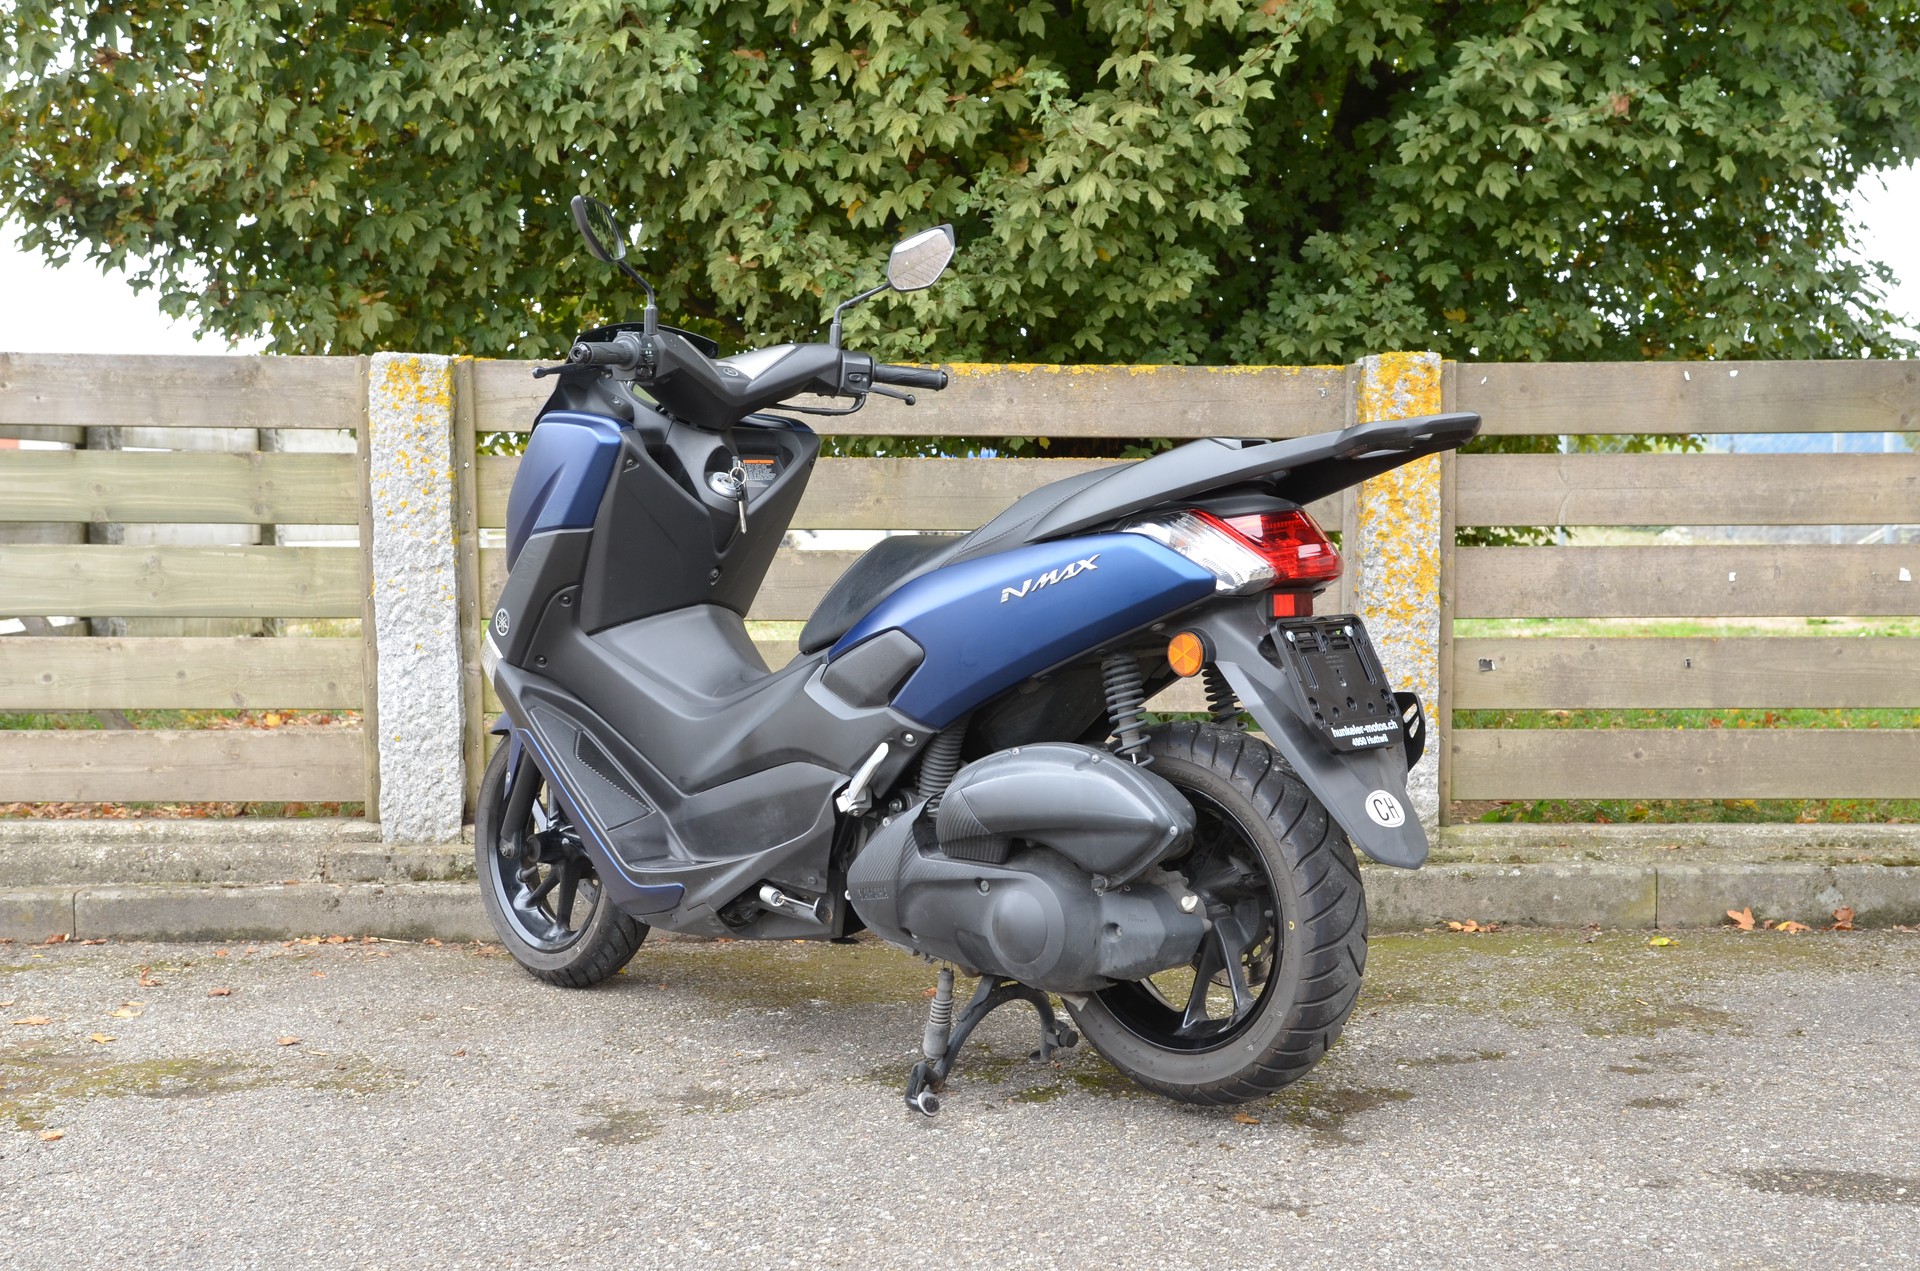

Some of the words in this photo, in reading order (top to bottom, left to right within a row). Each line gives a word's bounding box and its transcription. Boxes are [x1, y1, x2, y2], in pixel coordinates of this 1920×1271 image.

[1000, 553, 1101, 603] NMAX
[1330, 719, 1399, 738] hunkeler-motos.ch
[1352, 736, 1367, 747] 4950
[1366, 733, 1389, 745] Huttwil
[1373, 797, 1400, 821] CH
